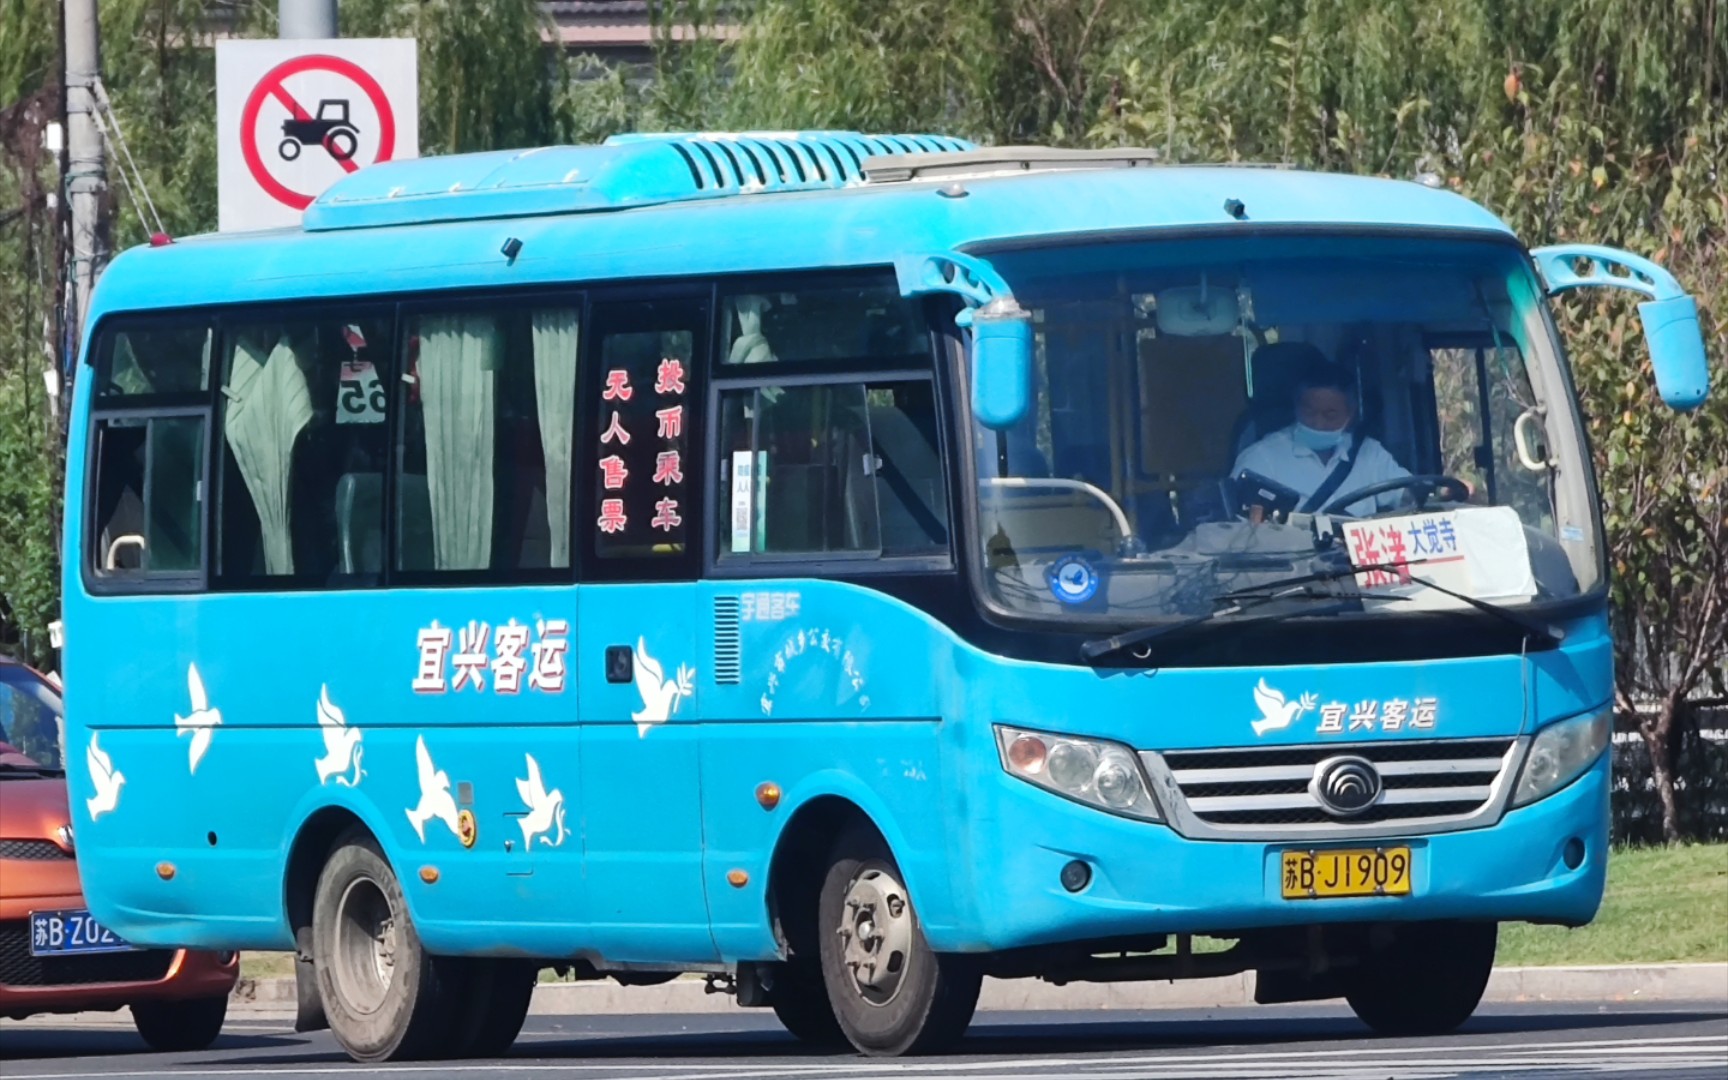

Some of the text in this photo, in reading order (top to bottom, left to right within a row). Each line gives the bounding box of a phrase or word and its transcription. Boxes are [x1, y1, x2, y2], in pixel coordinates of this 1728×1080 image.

[598, 370, 632, 533] 无人售票
[651, 358, 685, 531] 投币乘车
[1408, 517, 1456, 554] 大觉寺
[412, 617, 569, 694] 宜兴客运
[1316, 696, 1438, 736] 宜兴客运
